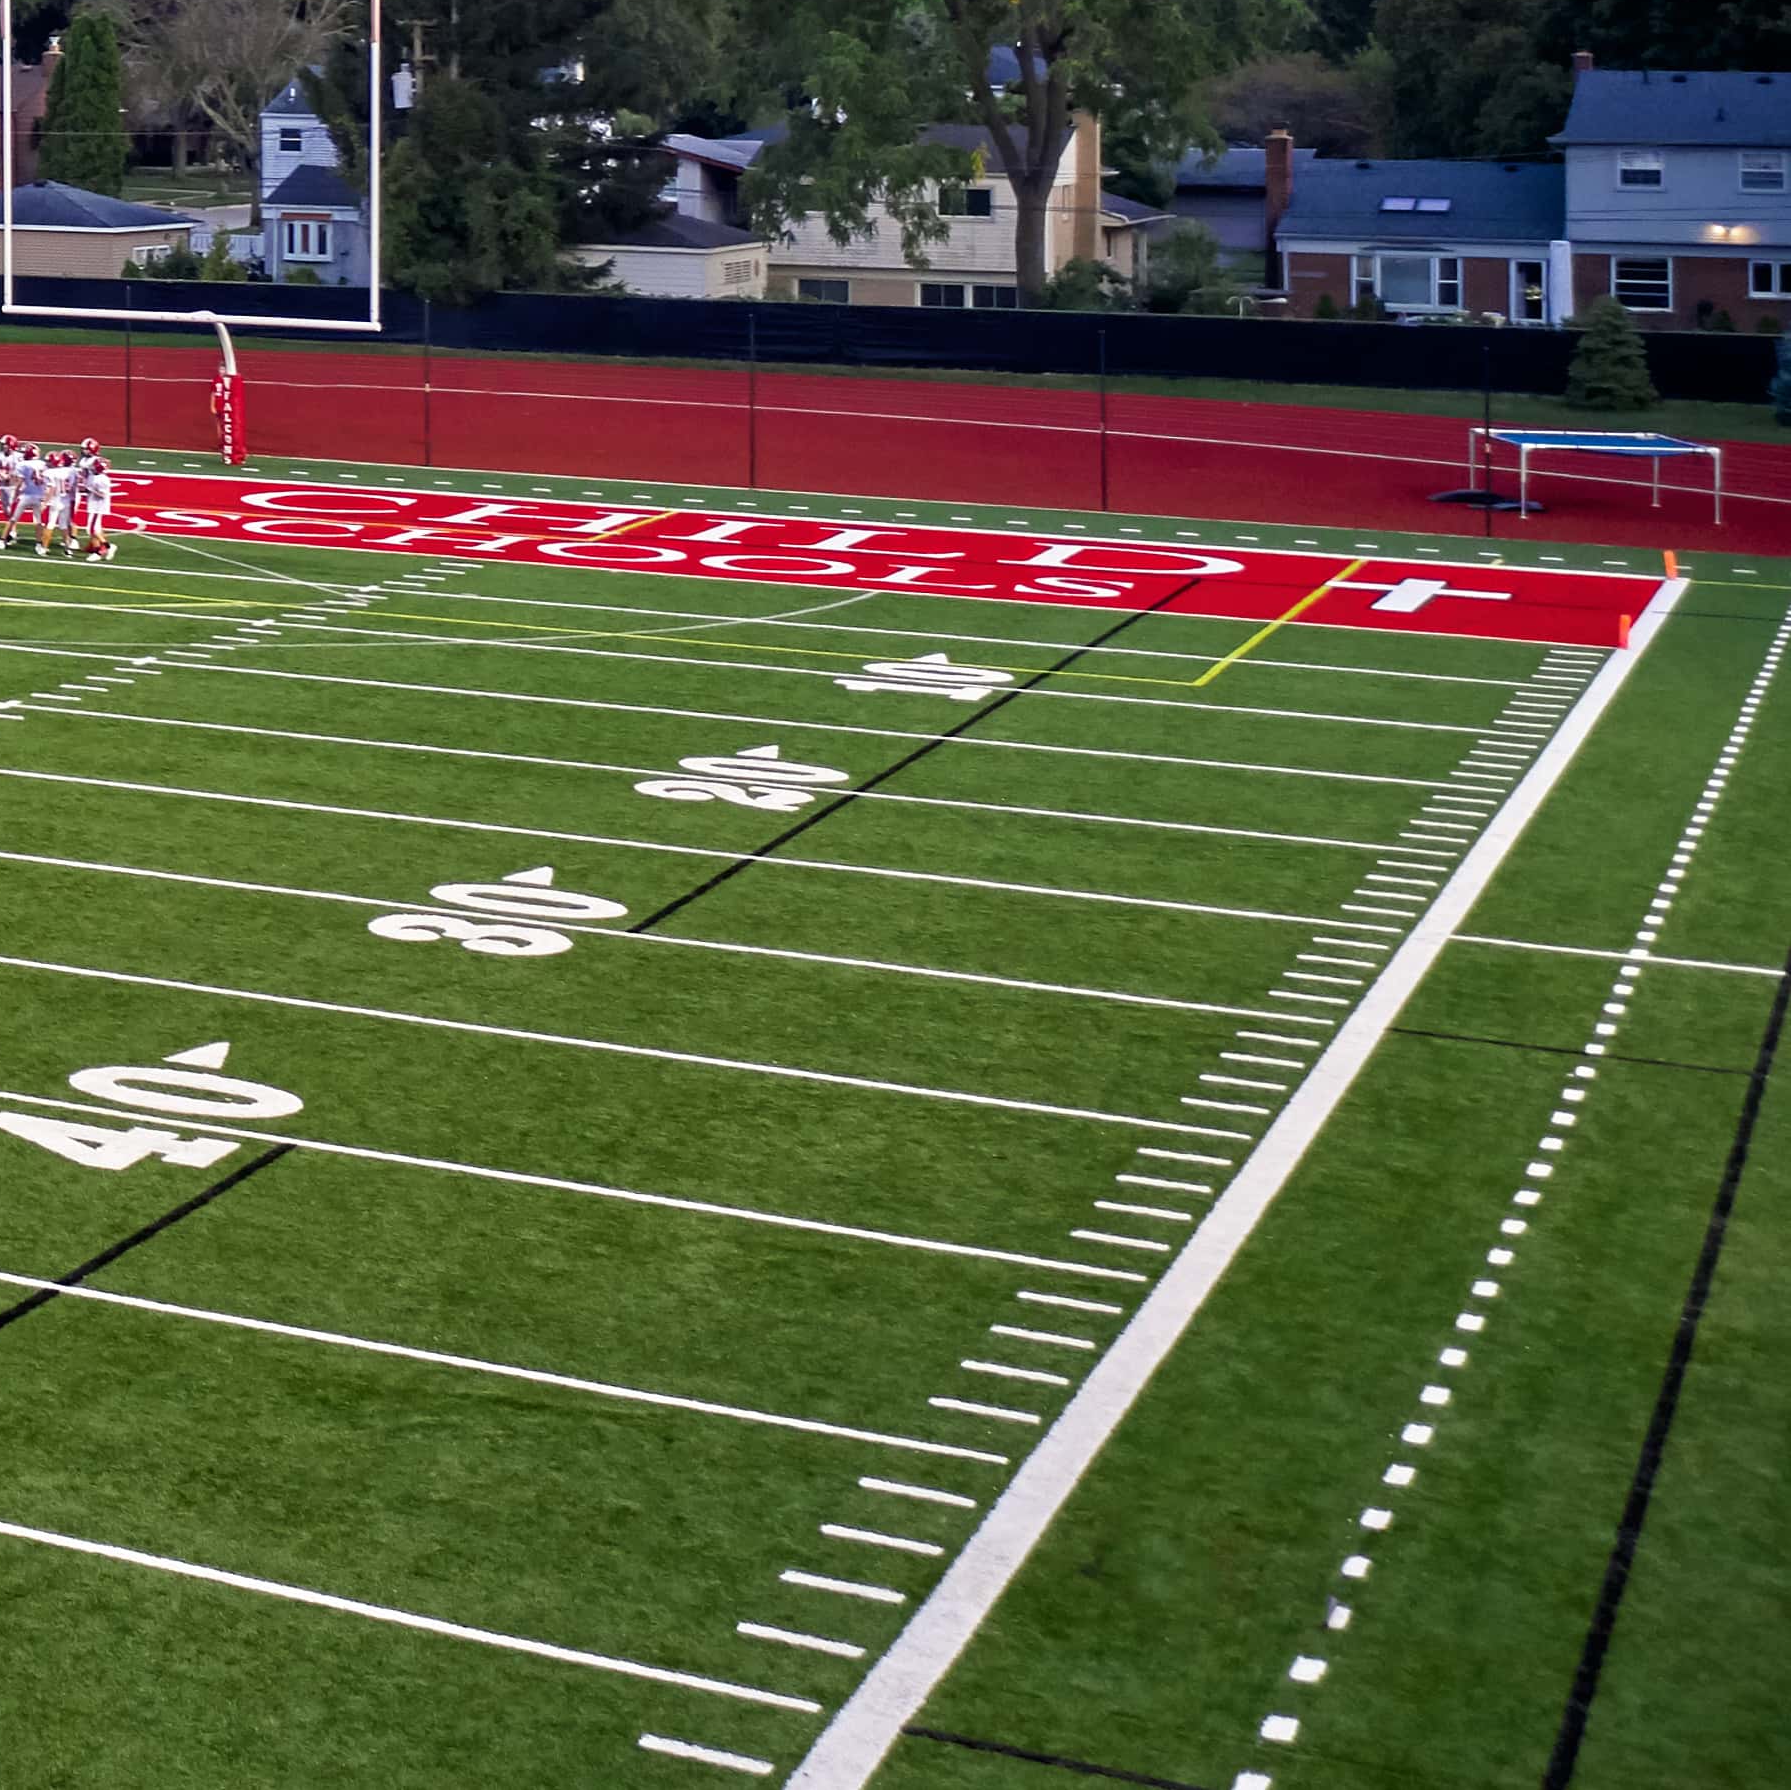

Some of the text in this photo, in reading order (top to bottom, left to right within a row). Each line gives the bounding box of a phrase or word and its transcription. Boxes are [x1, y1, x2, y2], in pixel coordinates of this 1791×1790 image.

[134, 509, 1134, 598] SCHOOLS
[240, 489, 1245, 574] CHILD
[833, 661, 1015, 701] 10
[633, 755, 850, 812] 20
[367, 881, 629, 957] 30
